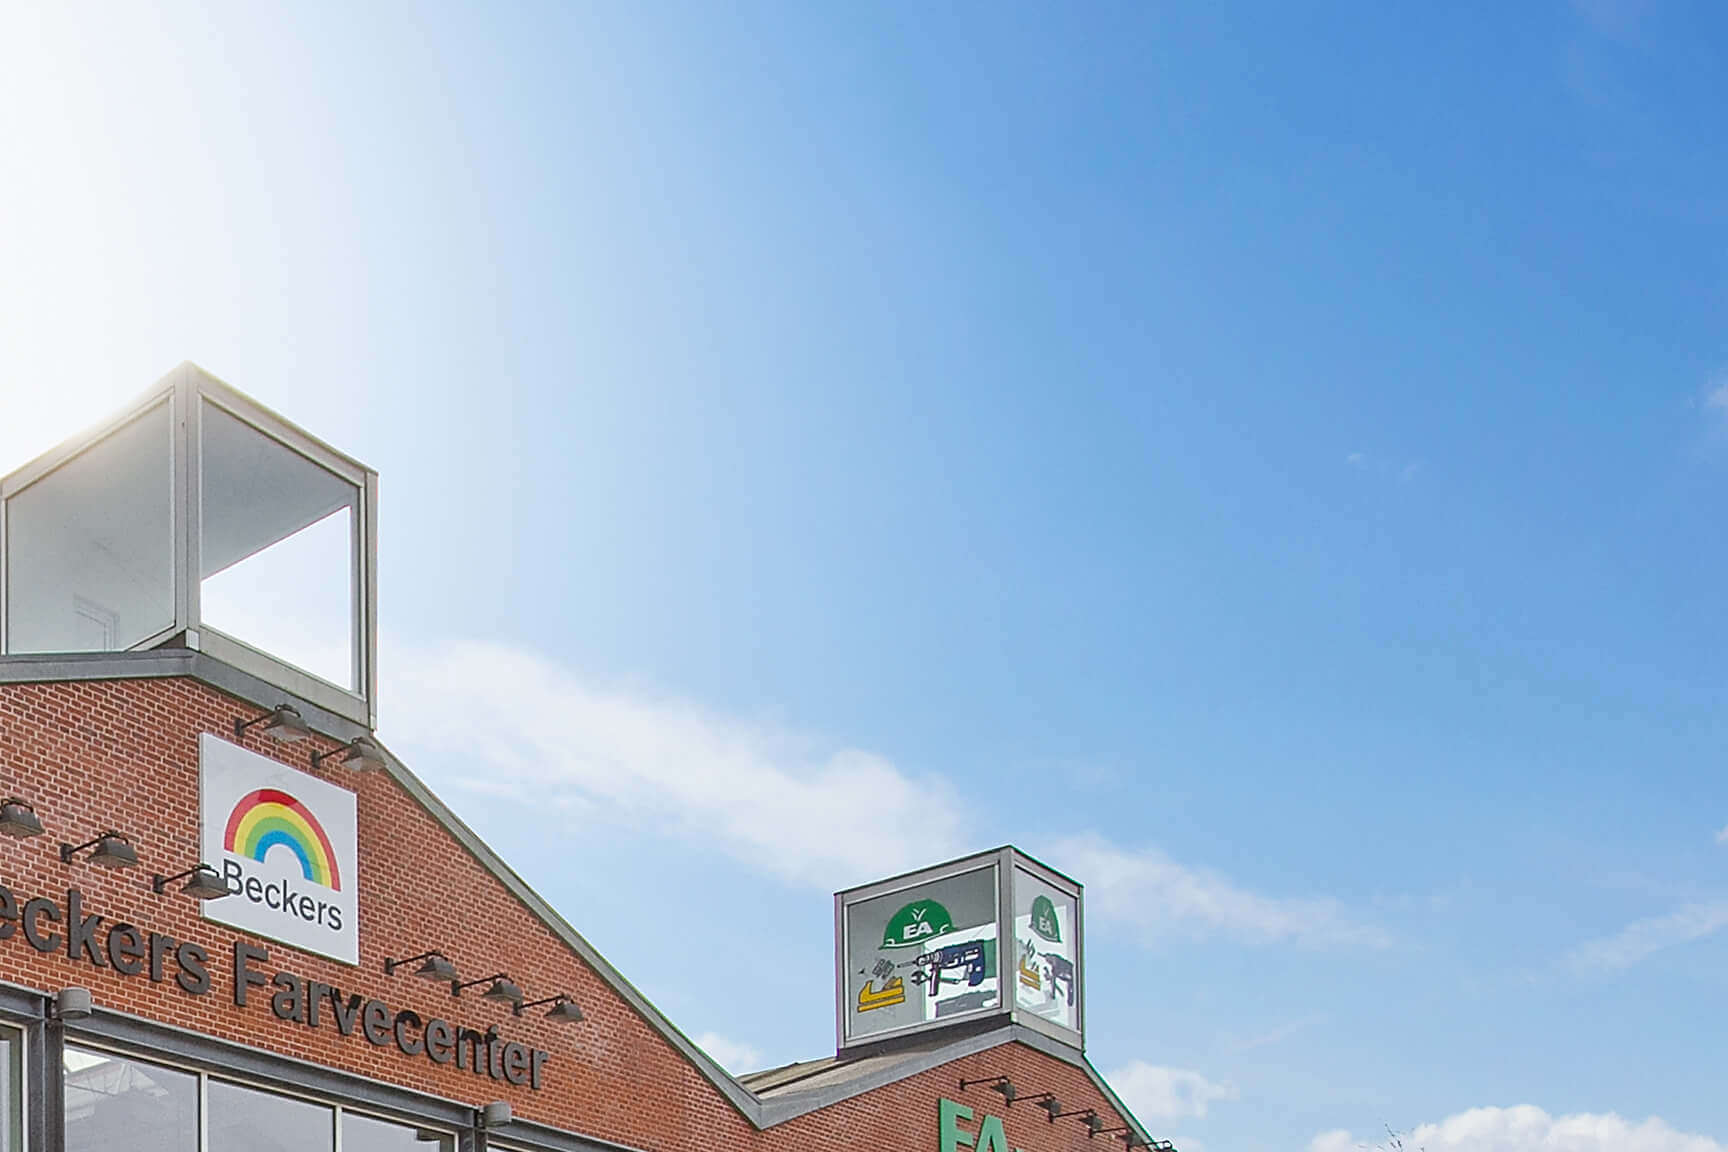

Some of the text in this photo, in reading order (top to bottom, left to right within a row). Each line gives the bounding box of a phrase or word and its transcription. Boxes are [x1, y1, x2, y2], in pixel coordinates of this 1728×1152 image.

[223, 857, 343, 932] Beckers
[903, 921, 933, 939] EA
[1038, 917, 1053, 935] EA
[233, 940, 550, 1091] Farvecenter
